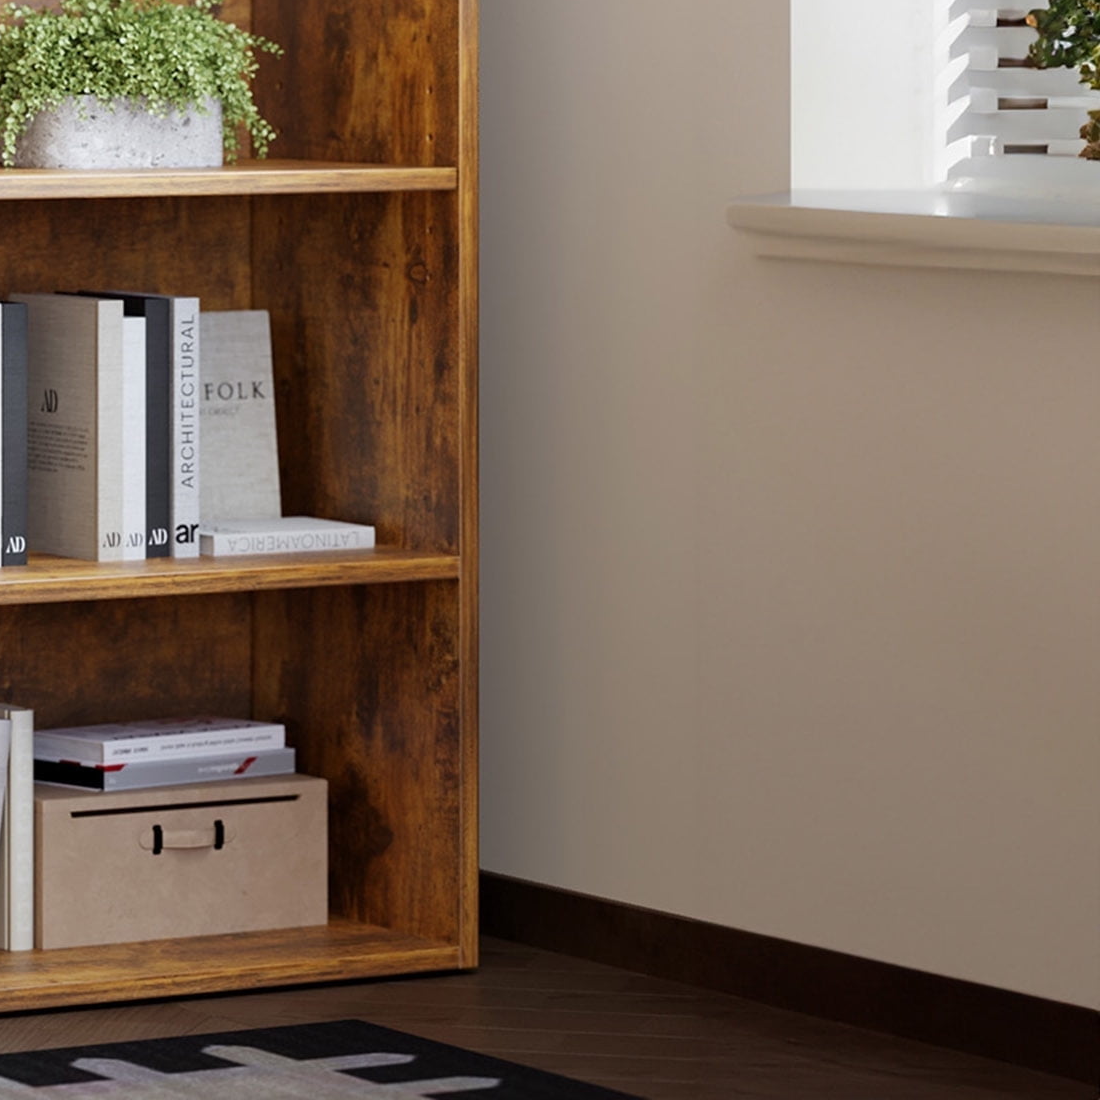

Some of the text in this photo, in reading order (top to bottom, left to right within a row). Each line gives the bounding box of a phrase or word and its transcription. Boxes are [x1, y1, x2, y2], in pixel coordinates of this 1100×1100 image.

[41, 388, 58, 413] AD
[180, 314, 195, 488] ARCHITECTURAL
[204, 381, 266, 401] FOLK
[103, 532, 121, 548] AD
[126, 532, 143, 548] AD
[148, 528, 168, 546] AD
[175, 523, 199, 544] ar
[228, 531, 360, 551] LATINOAMERICA
[5, 536, 26, 554] AD
